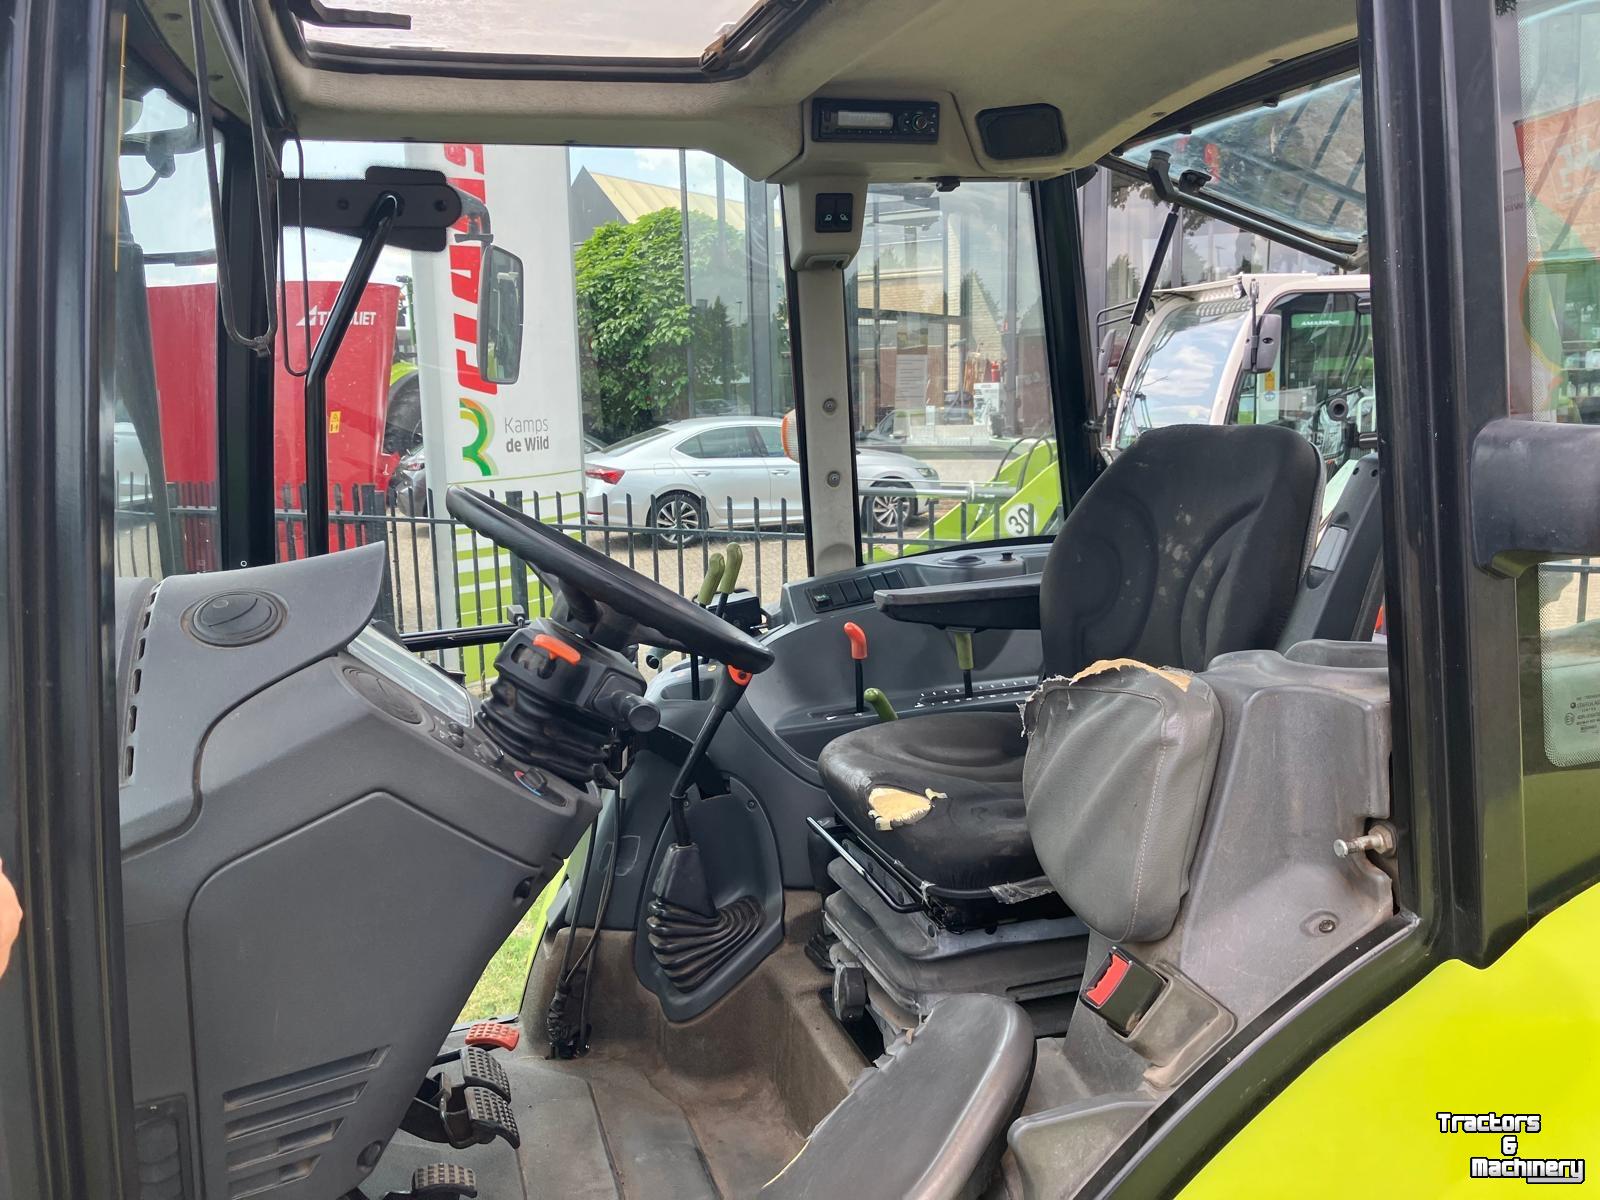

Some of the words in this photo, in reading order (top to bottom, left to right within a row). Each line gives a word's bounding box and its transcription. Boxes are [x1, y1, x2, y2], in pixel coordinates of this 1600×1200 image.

[317, 311, 377, 326] TLIET
[504, 417, 549, 434] Kamps
[506, 438, 522, 453] de
[524, 436, 550, 452] Wild
[1008, 507, 1031, 534] 30
